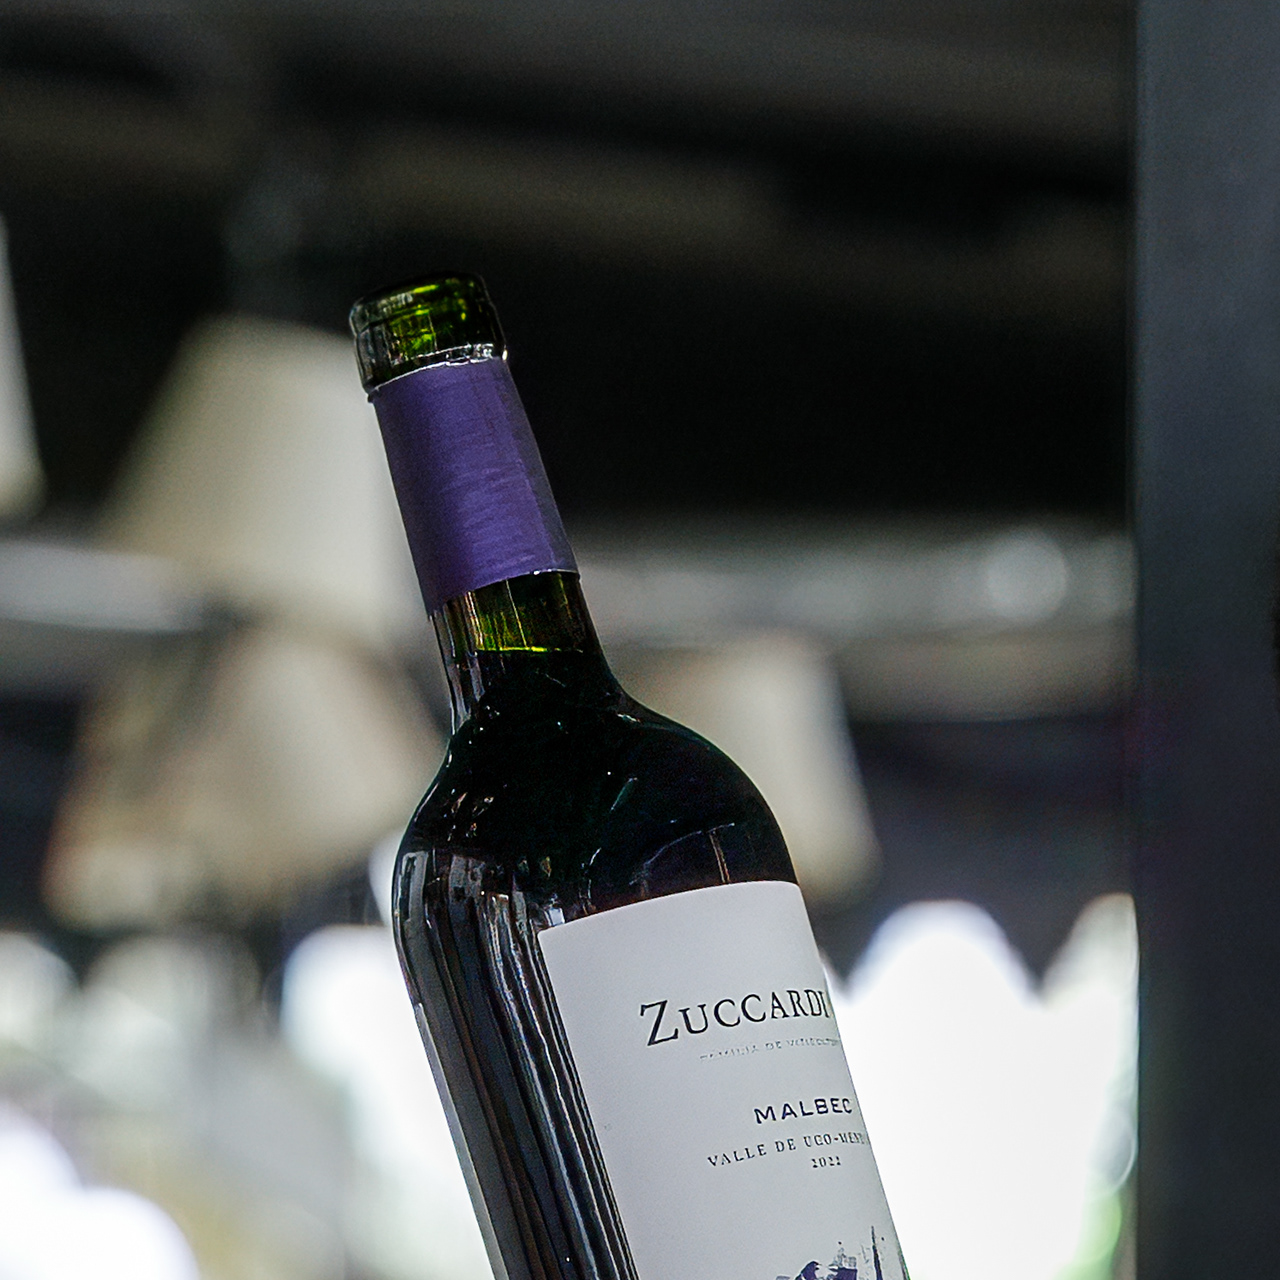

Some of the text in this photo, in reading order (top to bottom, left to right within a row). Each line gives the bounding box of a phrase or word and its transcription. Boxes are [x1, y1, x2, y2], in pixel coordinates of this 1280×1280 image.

[640, 989, 831, 1046] ZUCCARDI
[754, 1097, 852, 1124] MALBEC
[707, 1143, 768, 1167] VALLE
[774, 1138, 797, 1152] DE
